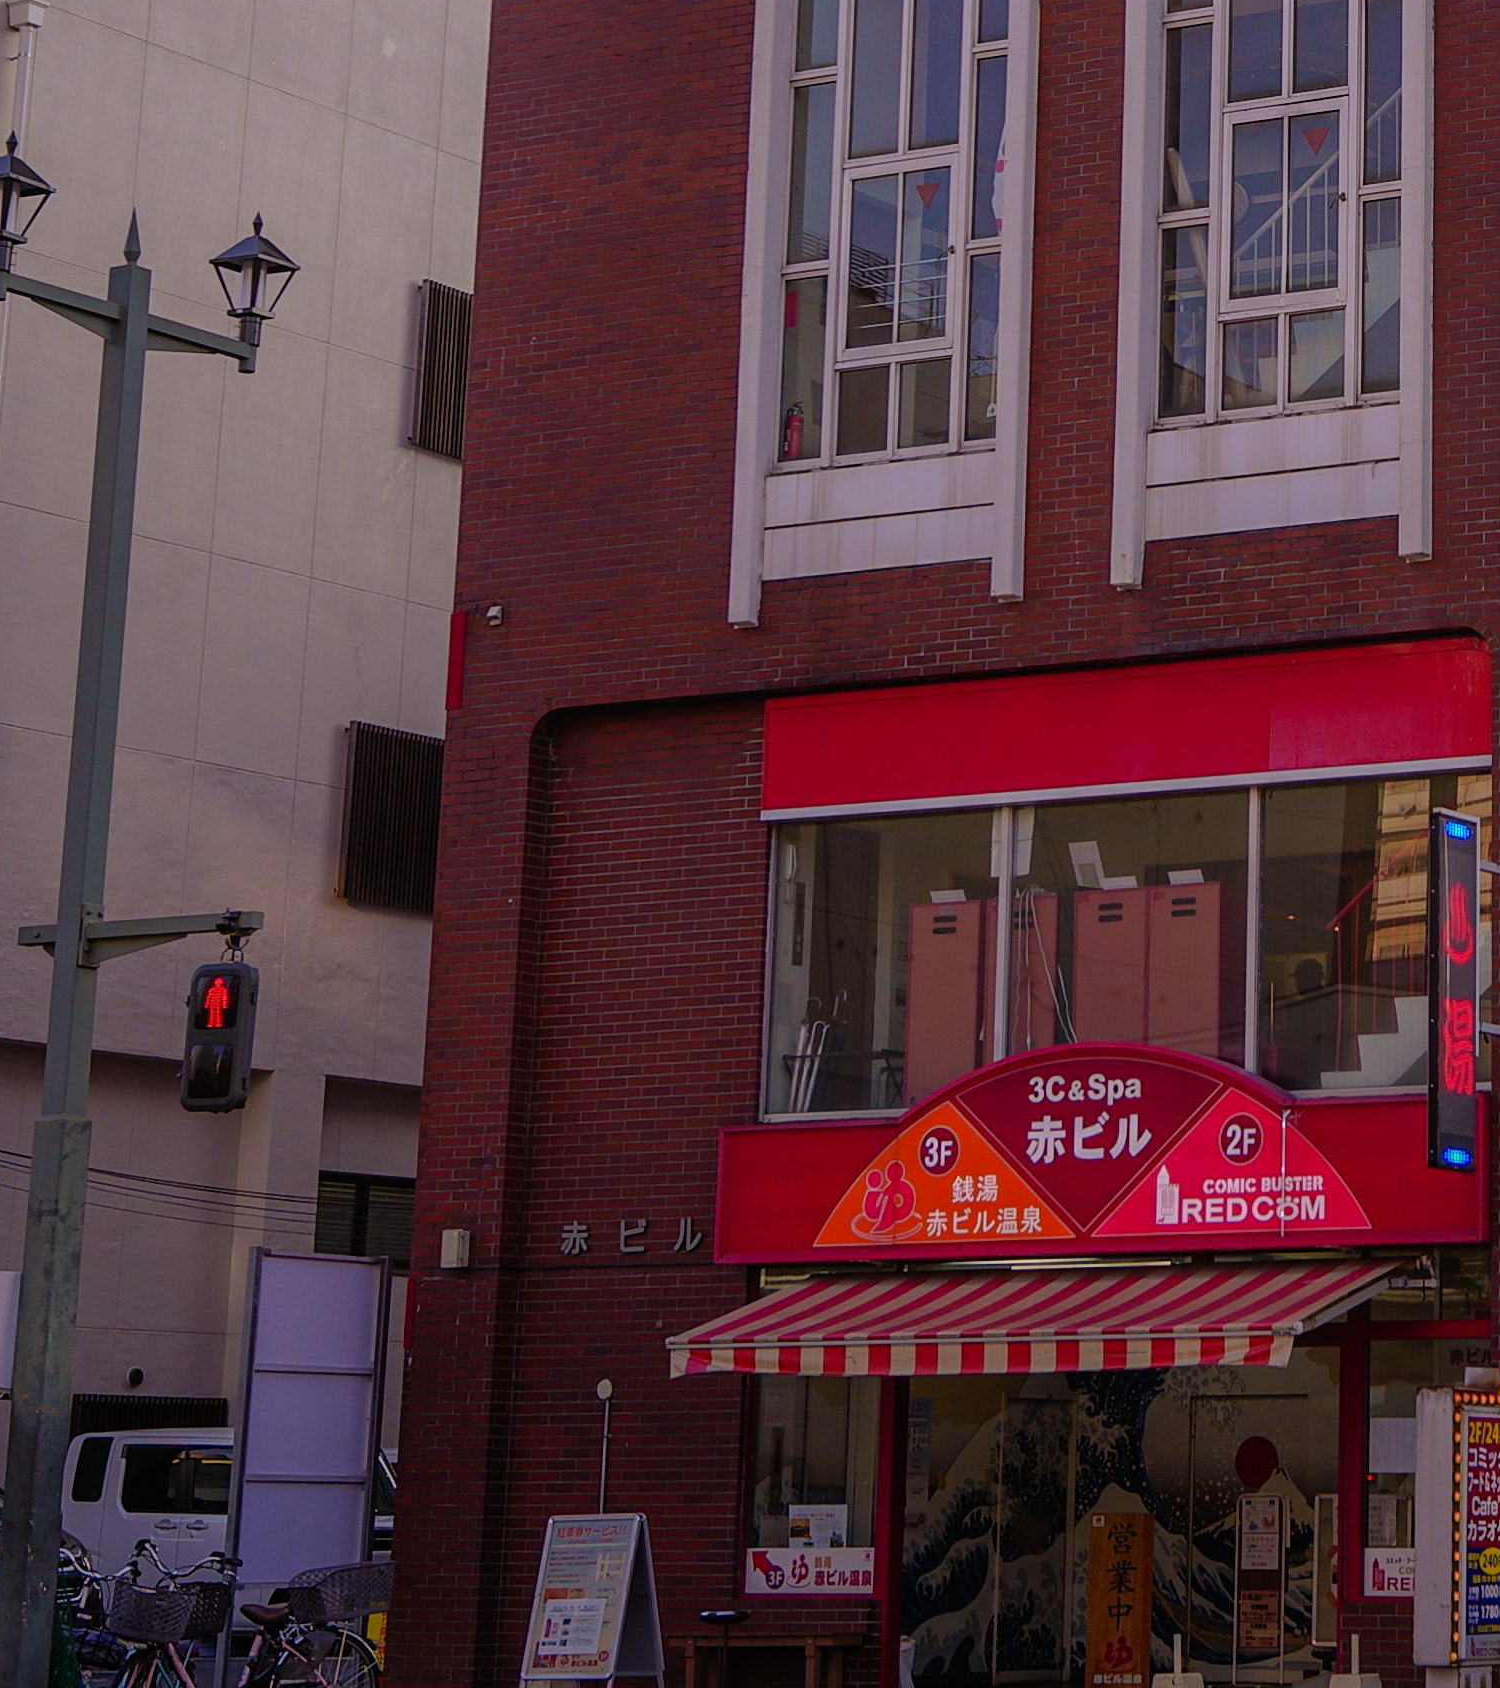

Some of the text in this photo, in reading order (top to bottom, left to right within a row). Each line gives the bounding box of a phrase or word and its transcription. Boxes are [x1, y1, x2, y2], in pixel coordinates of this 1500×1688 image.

[1028, 1073, 1142, 1107] 3C&Spa
[924, 1136, 954, 1168] 3F
[1026, 1111, 1153, 1164] 赤ビル
[1226, 1124, 1257, 1156] 2F
[951, 1174, 999, 1203] 銭湯
[1202, 1175, 1324, 1195] COMIC BUSTER
[560, 1215, 702, 1255] 赤ビル
[926, 1205, 1042, 1237] 赤ビル温泉
[768, 1570, 783, 1585] 3F
[814, 1569, 872, 1586] 赤ビル温泉
[1106, 1523, 1137, 1631] 営業中
[1387, 1578, 1415, 1591] RE
[1399, 1566, 1415, 1575] CO
